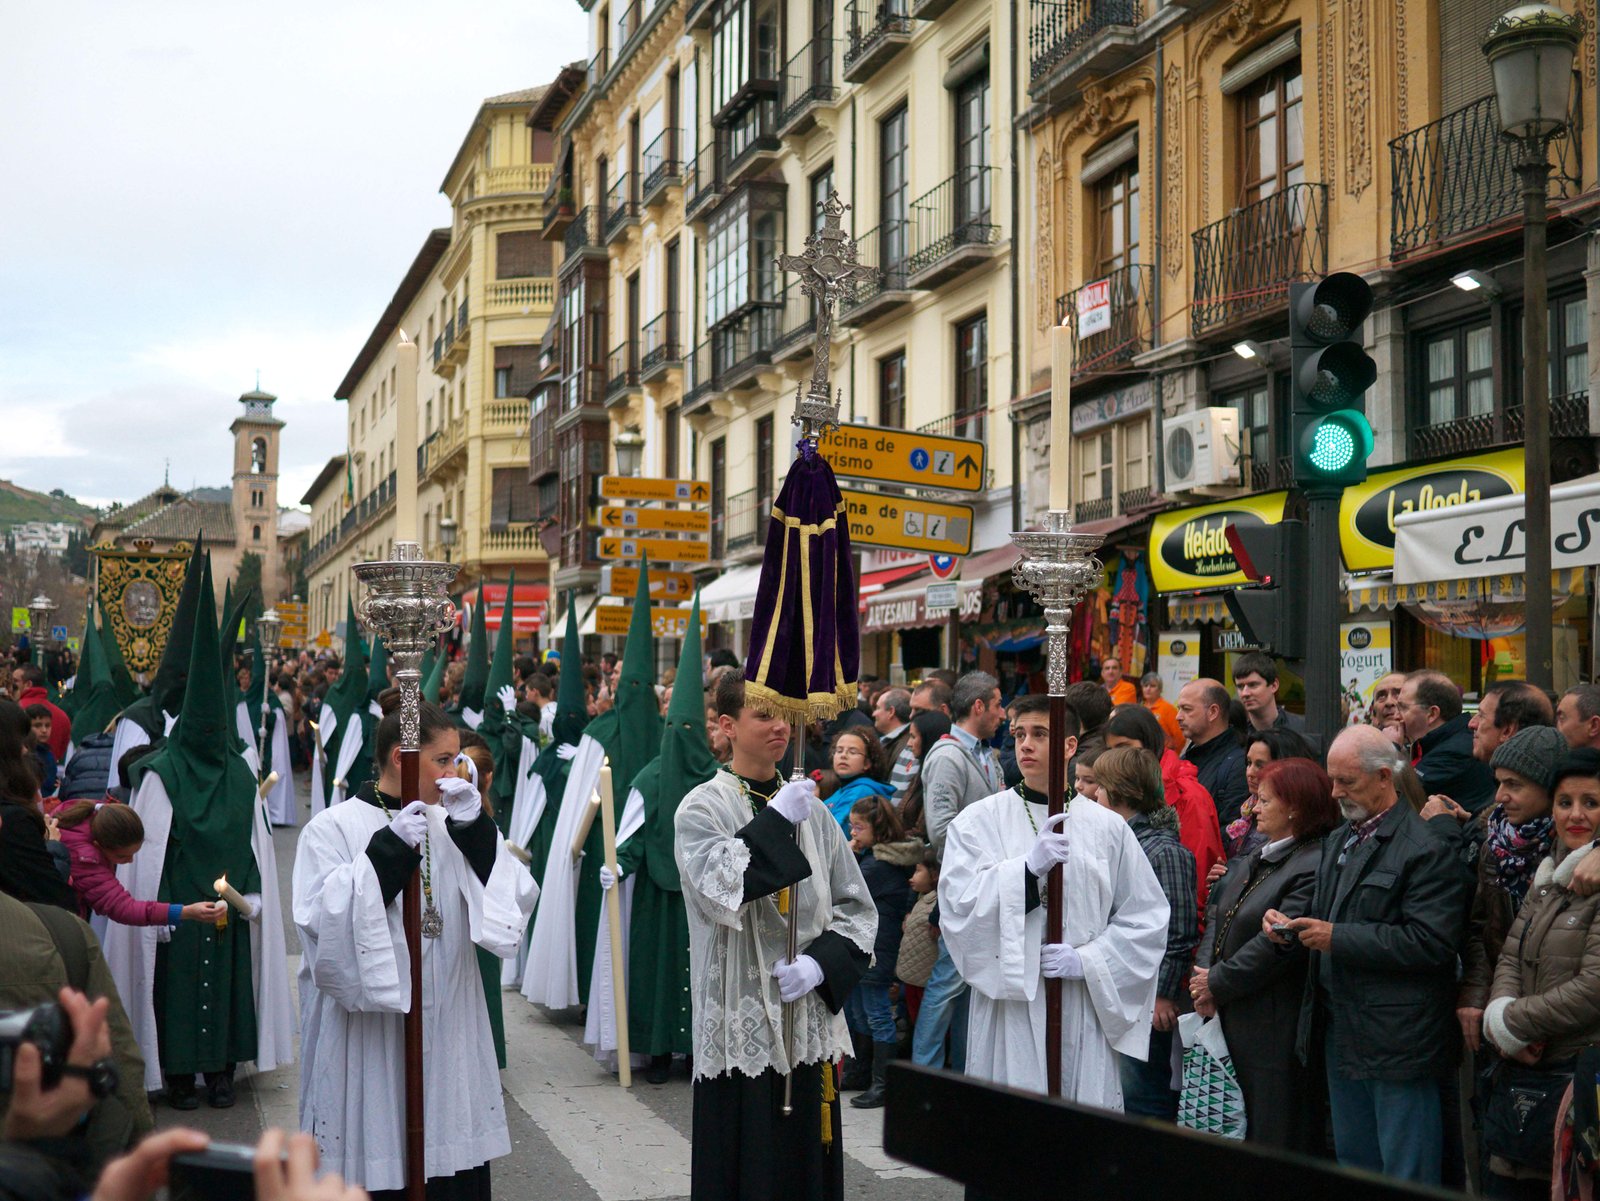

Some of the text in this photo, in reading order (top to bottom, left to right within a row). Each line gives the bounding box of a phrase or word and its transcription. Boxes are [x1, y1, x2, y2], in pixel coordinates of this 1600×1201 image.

[821, 429, 895, 453] ficina de
[822, 451, 873, 470] rismo
[879, 504, 898, 519] de
[1388, 489, 1414, 533] La
[1184, 516, 1233, 560] Helad
[1382, 575, 1527, 600] HELADOS ARTESAN
[1340, 652, 1384, 672] Yogurt
